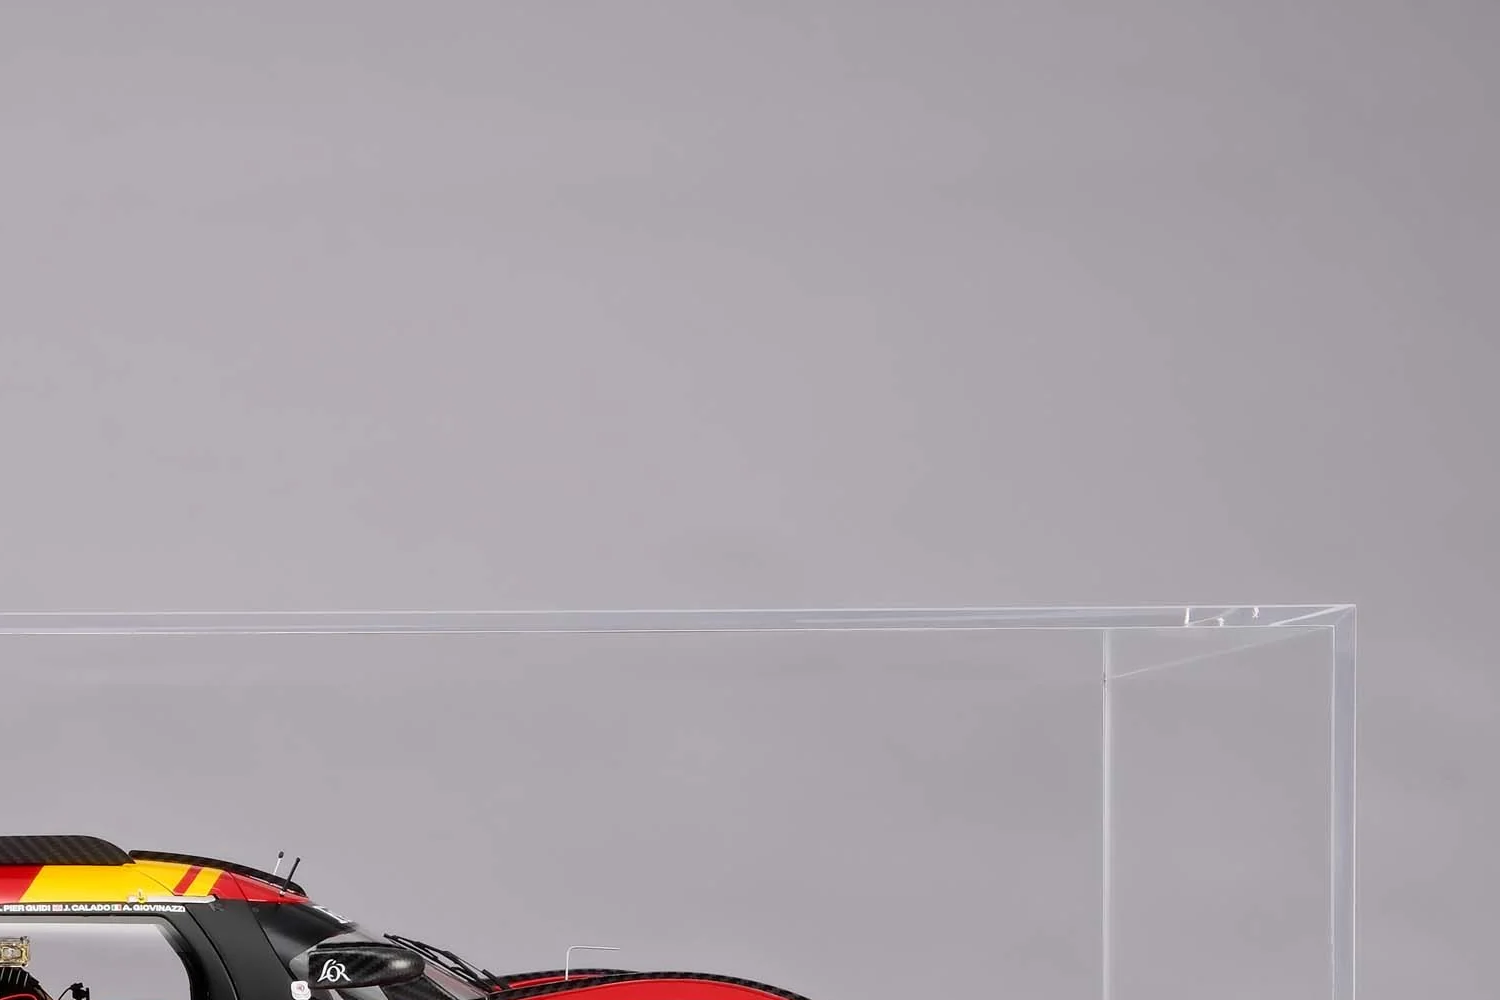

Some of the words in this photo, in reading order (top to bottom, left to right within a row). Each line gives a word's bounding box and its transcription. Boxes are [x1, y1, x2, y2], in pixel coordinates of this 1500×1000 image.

[3, 904, 25, 912] PIER
[26, 904, 51, 912] GUIDI
[71, 904, 111, 912] CALADO
